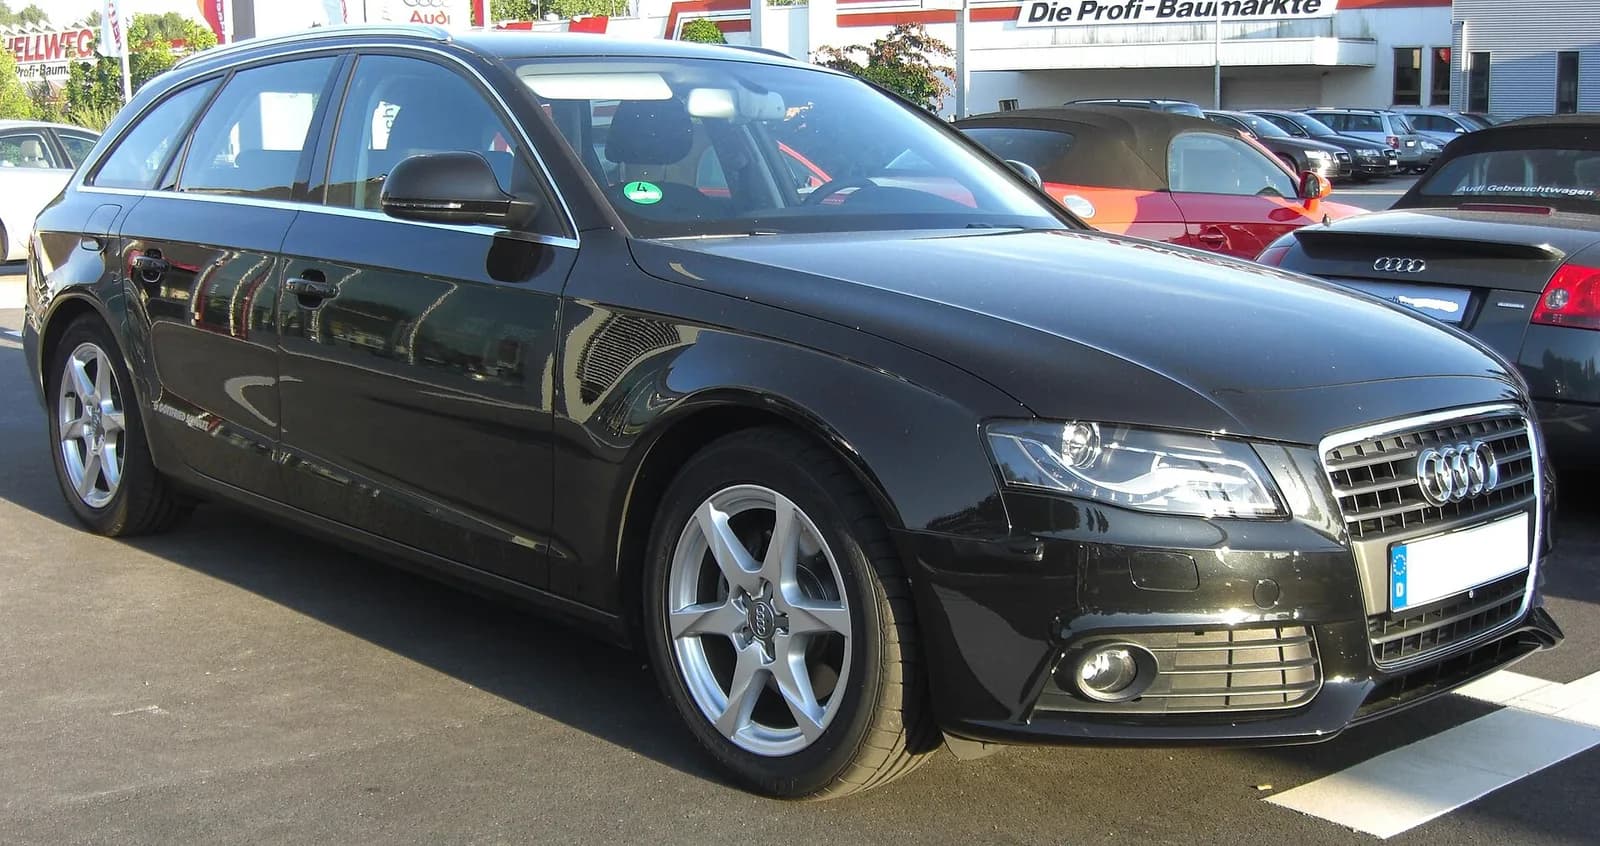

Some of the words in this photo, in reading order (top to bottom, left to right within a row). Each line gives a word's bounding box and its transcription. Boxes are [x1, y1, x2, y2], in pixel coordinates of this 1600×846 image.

[1028, 2, 1072, 22] Die
[637, 182, 647, 192] 4
[1487, 184, 1594, 196] Gebrauchtwagen
[1396, 583, 1404, 598] D
